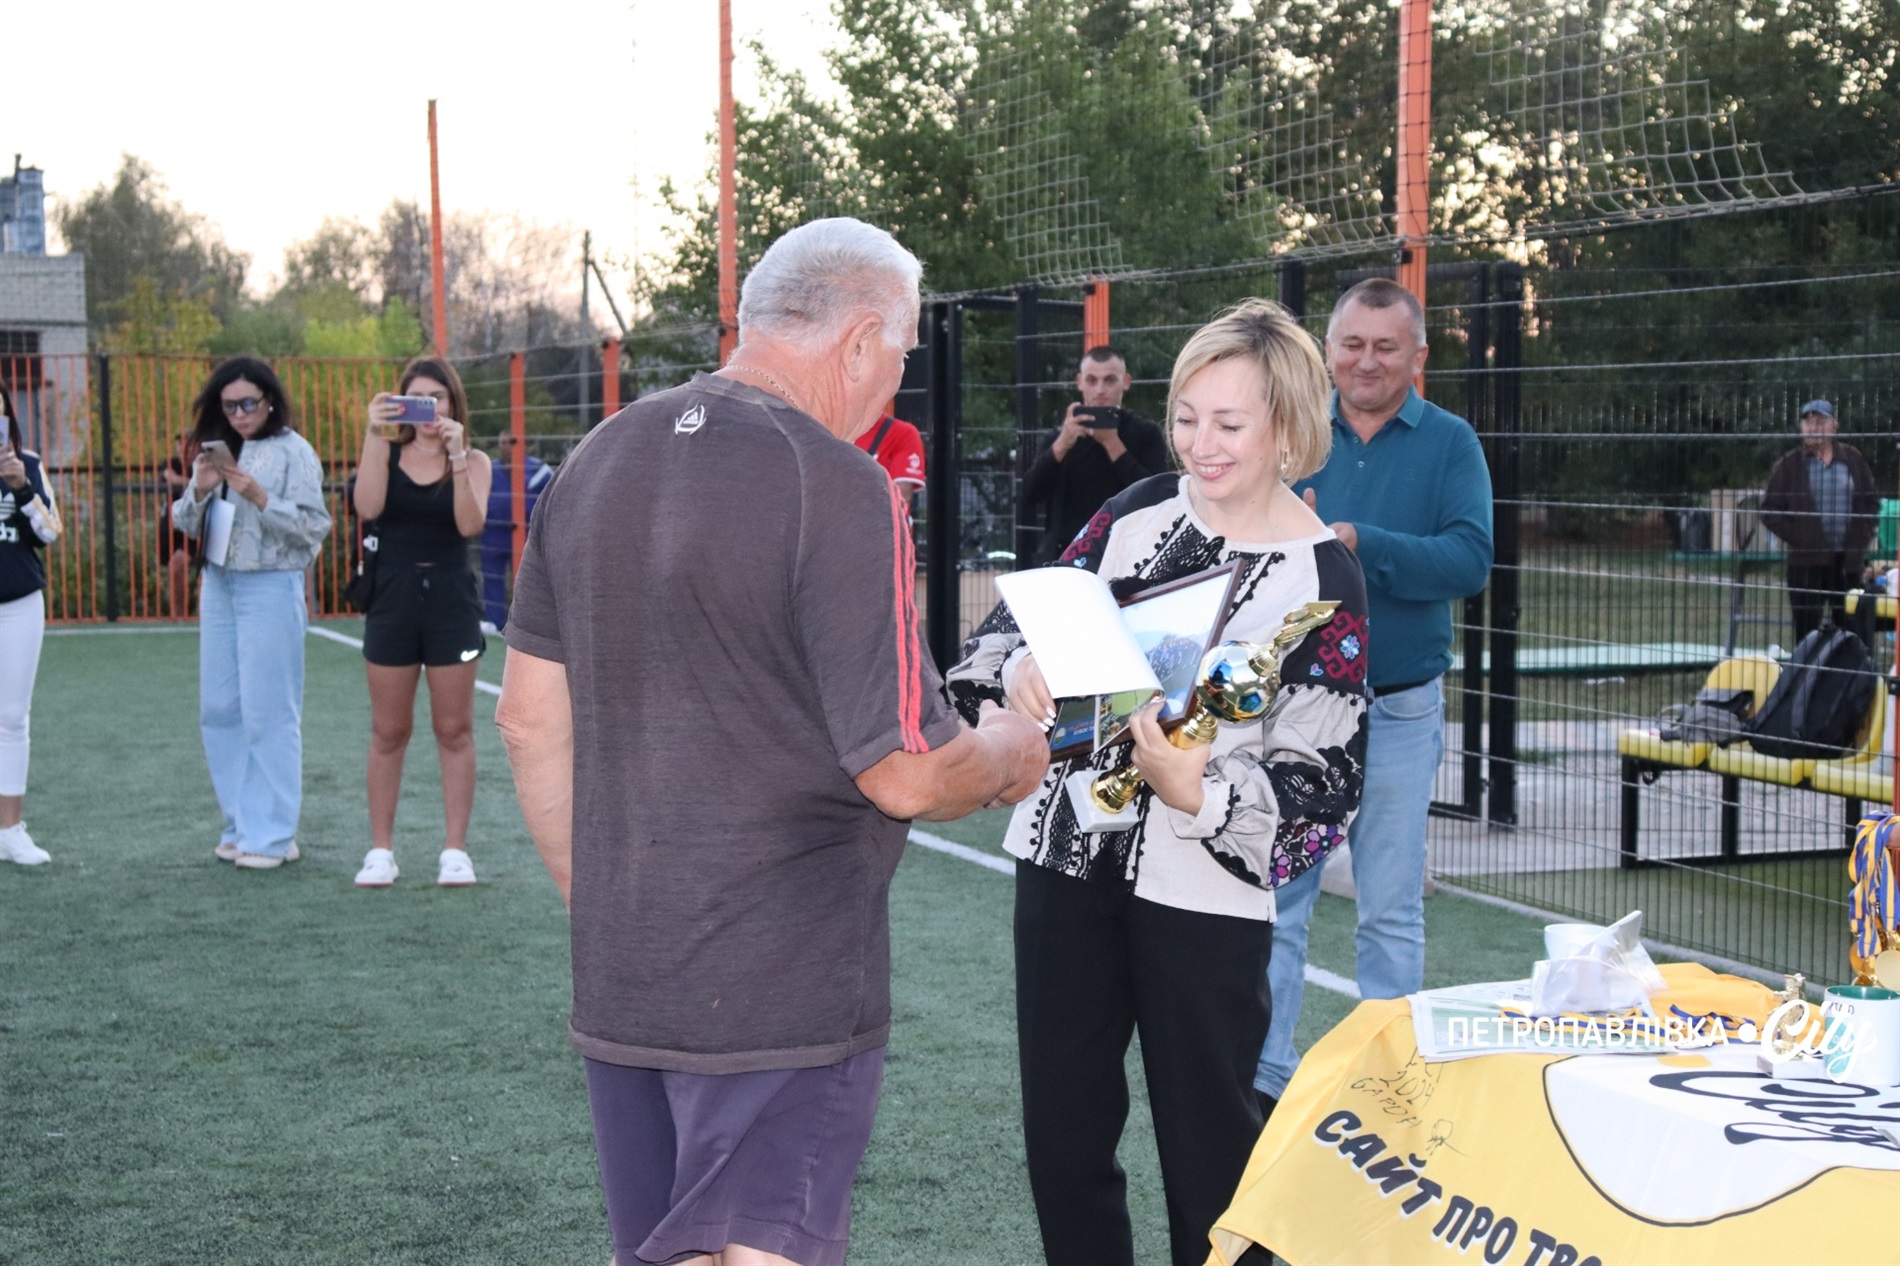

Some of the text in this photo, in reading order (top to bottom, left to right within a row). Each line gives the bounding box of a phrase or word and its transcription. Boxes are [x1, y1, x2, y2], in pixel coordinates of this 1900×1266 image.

[1314, 1110, 1443, 1218] САЙТ
[1431, 1195, 1519, 1266] ПРО
[1523, 1228, 1603, 1266] ТВ
